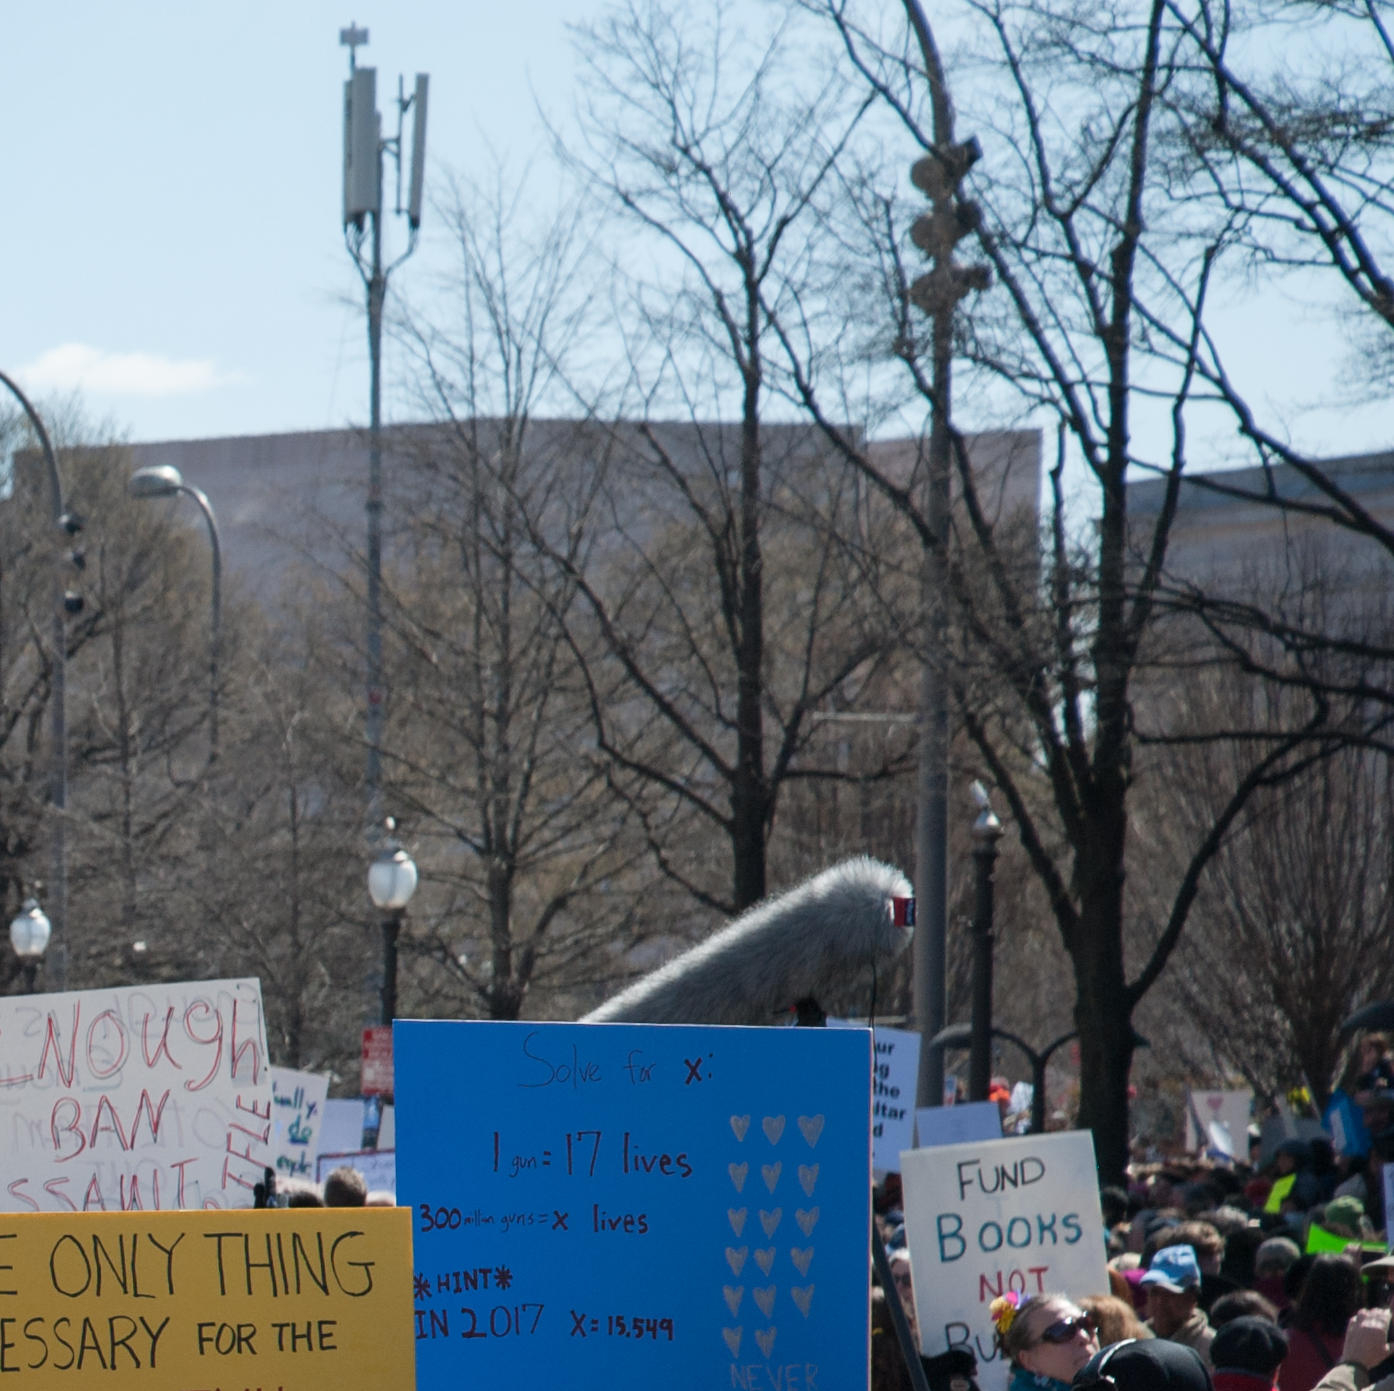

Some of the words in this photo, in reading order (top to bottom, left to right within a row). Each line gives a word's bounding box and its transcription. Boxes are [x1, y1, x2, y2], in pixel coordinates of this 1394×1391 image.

[517, 1031, 602, 1090] Solve
[623, 1049, 657, 1085] for
[50, 1088, 171, 1164] BAN
[566, 1130, 602, 1177] 17
[623, 1131, 693, 1178] lives
[956, 1156, 1046, 1202] FUND
[419, 1203, 462, 1233] 300
[463, 1208, 495, 1225] million
[593, 1203, 649, 1234] lives
[936, 1212, 1084, 1264] BOOKS
[49, 1231, 186, 1299] ONLY
[202, 1230, 376, 1298] THING
[979, 1265, 1049, 1302] NOT
[197, 1320, 258, 1356] FOR
[270, 1319, 339, 1353] THE
[414, 1308, 450, 1340] IN
[460, 1303, 546, 1339] 2017
[944, 1321, 998, 1364] BU
